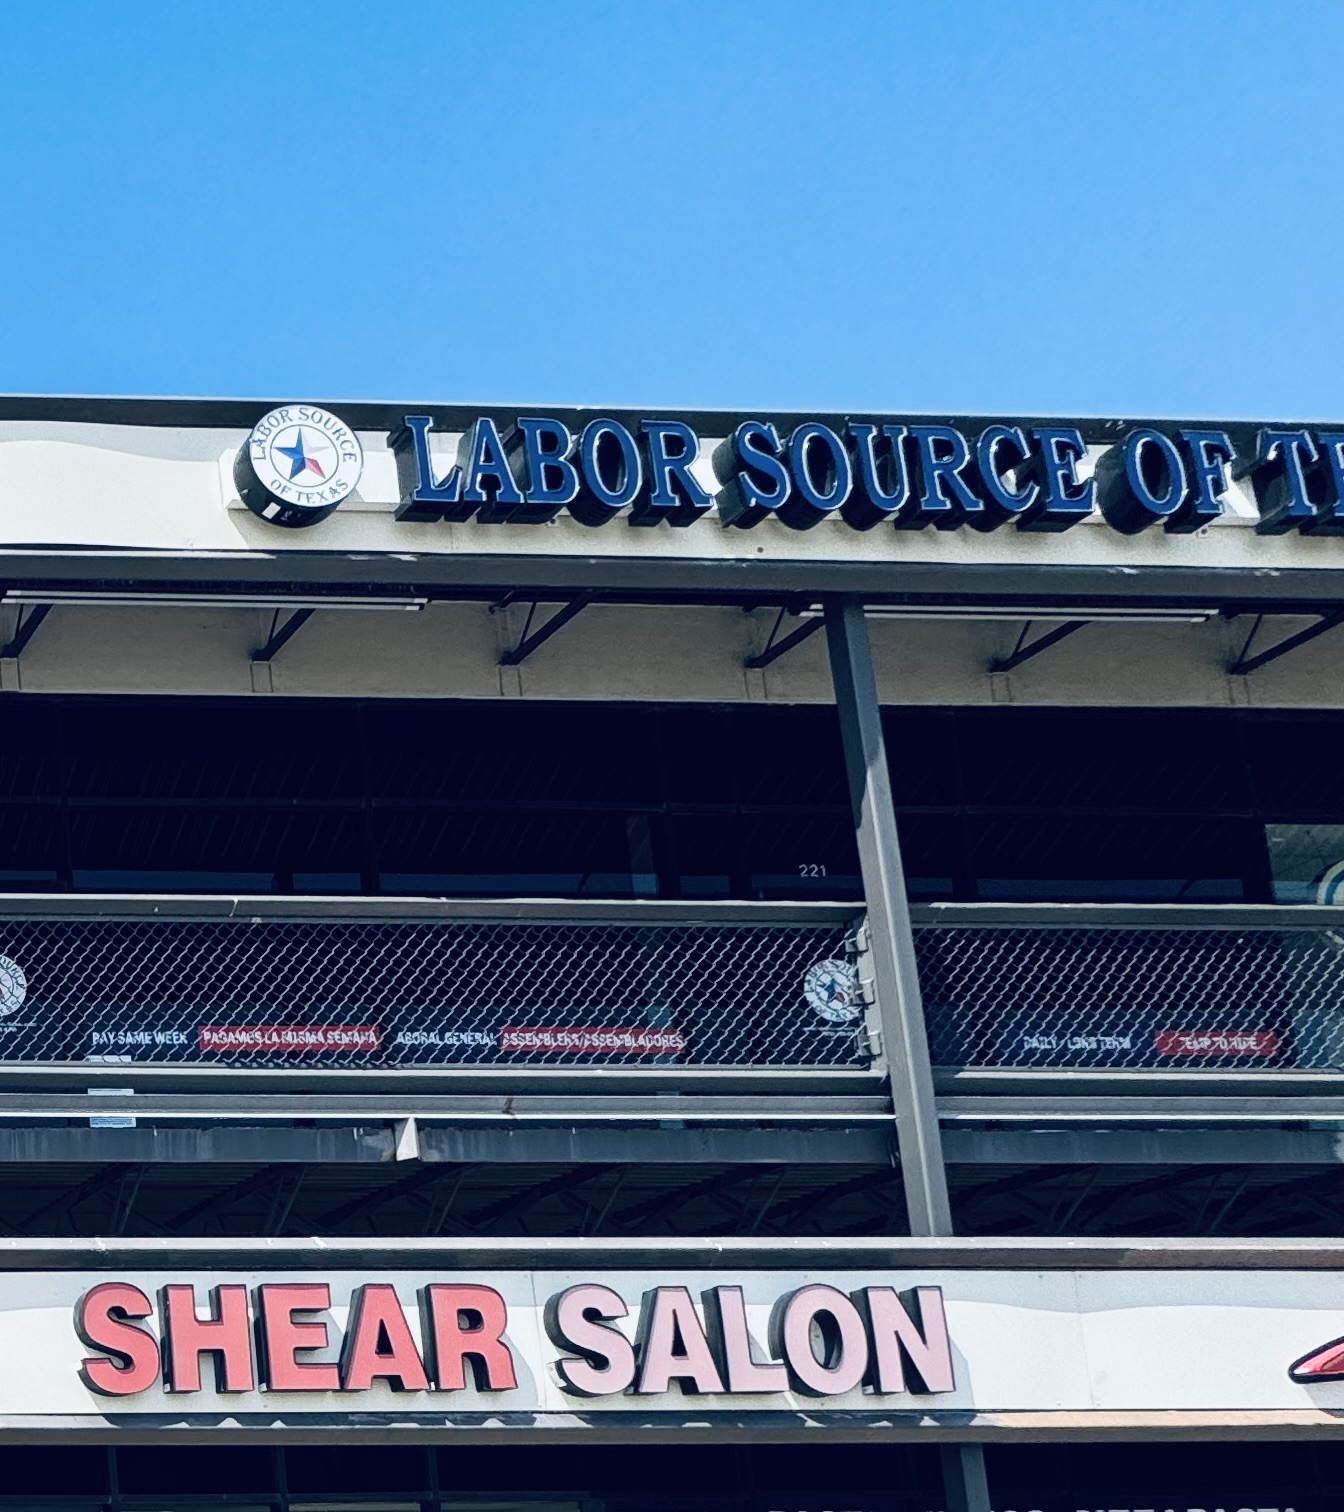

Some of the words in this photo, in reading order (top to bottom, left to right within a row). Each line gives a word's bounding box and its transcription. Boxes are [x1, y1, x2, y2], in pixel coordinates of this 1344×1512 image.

[252, 408, 294, 461] LABOR
[298, 407, 358, 463] SOURCE
[270, 479, 292, 495] OF
[296, 478, 349, 504] TEXAS
[411, 415, 715, 511] LABOR
[738, 420, 1097, 515] SOURCE
[1127, 428, 1236, 516] OF
[799, 864, 827, 878] 221
[76, 1281, 518, 1394] SHEAR
[548, 1283, 957, 1397] SALON
